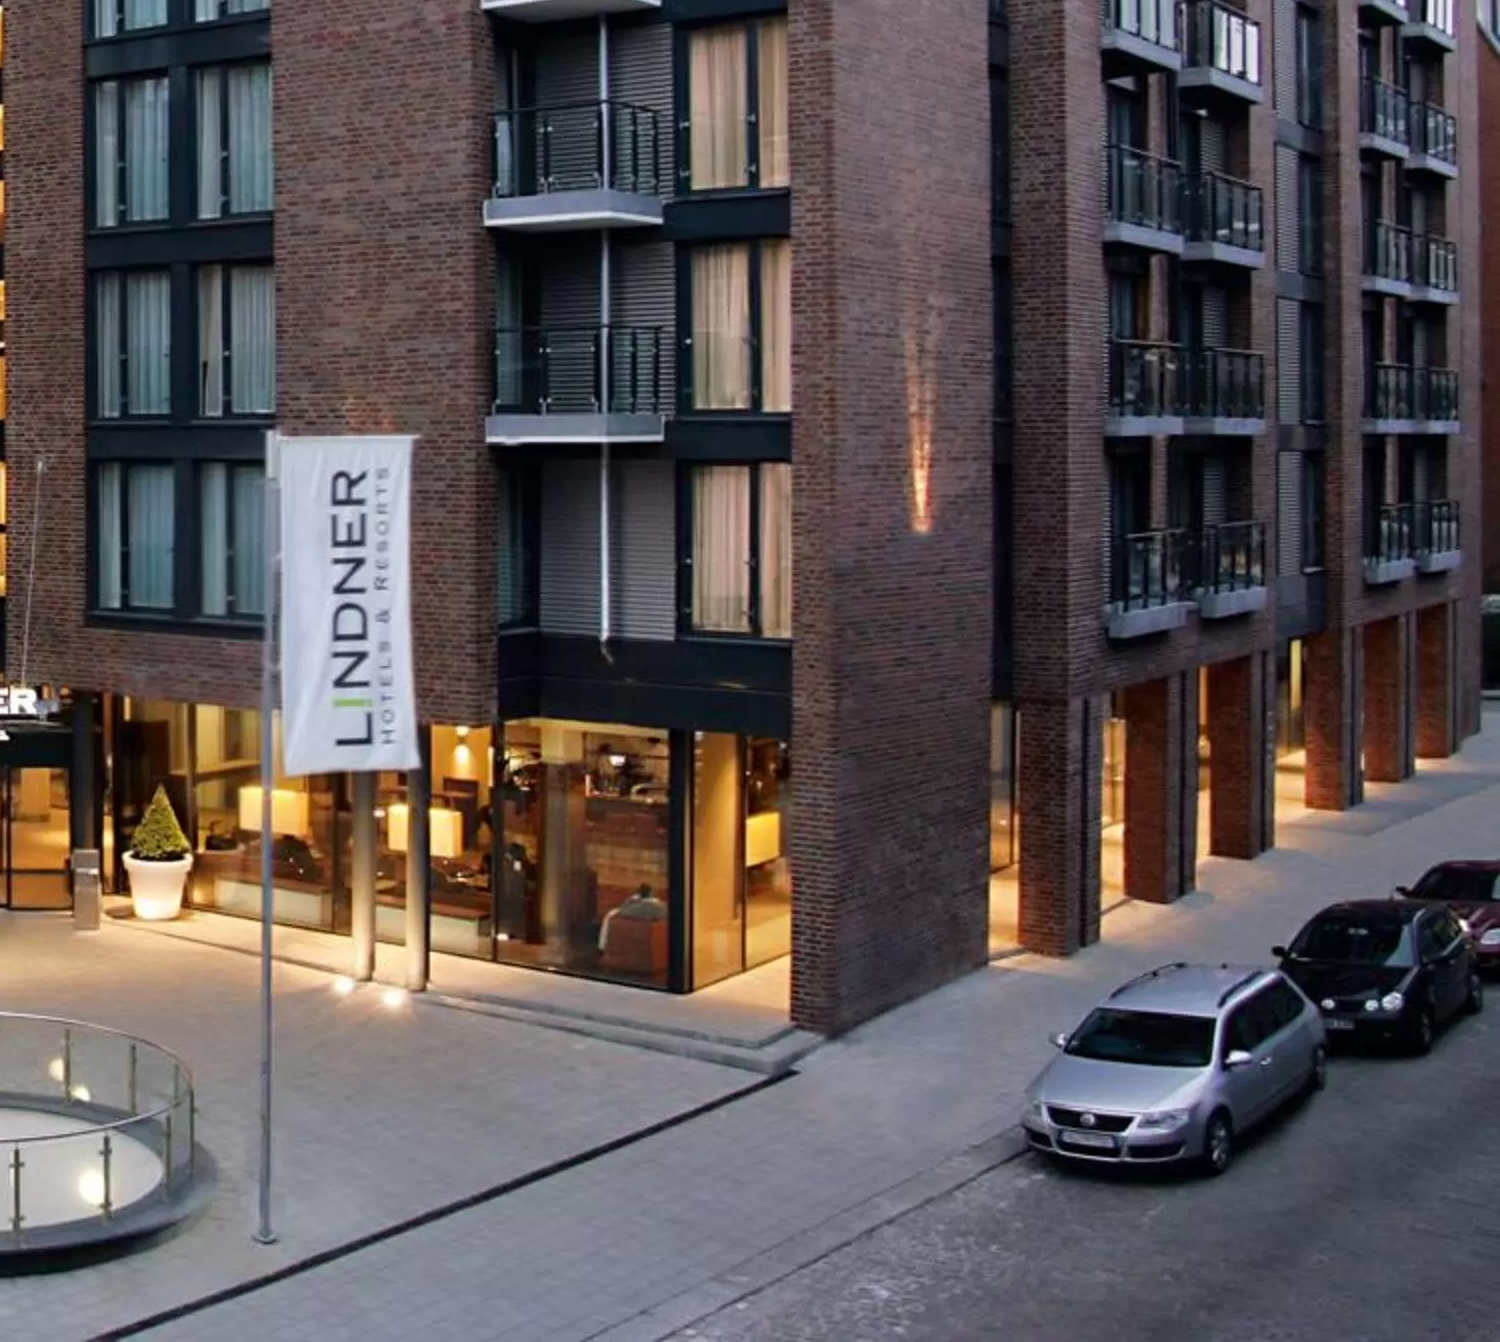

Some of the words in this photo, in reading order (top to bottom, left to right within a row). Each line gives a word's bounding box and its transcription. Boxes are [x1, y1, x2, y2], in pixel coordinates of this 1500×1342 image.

[373, 466, 390, 592] RESORTS
[330, 469, 374, 747] LINDNER
[377, 640, 397, 746] HOTELS
